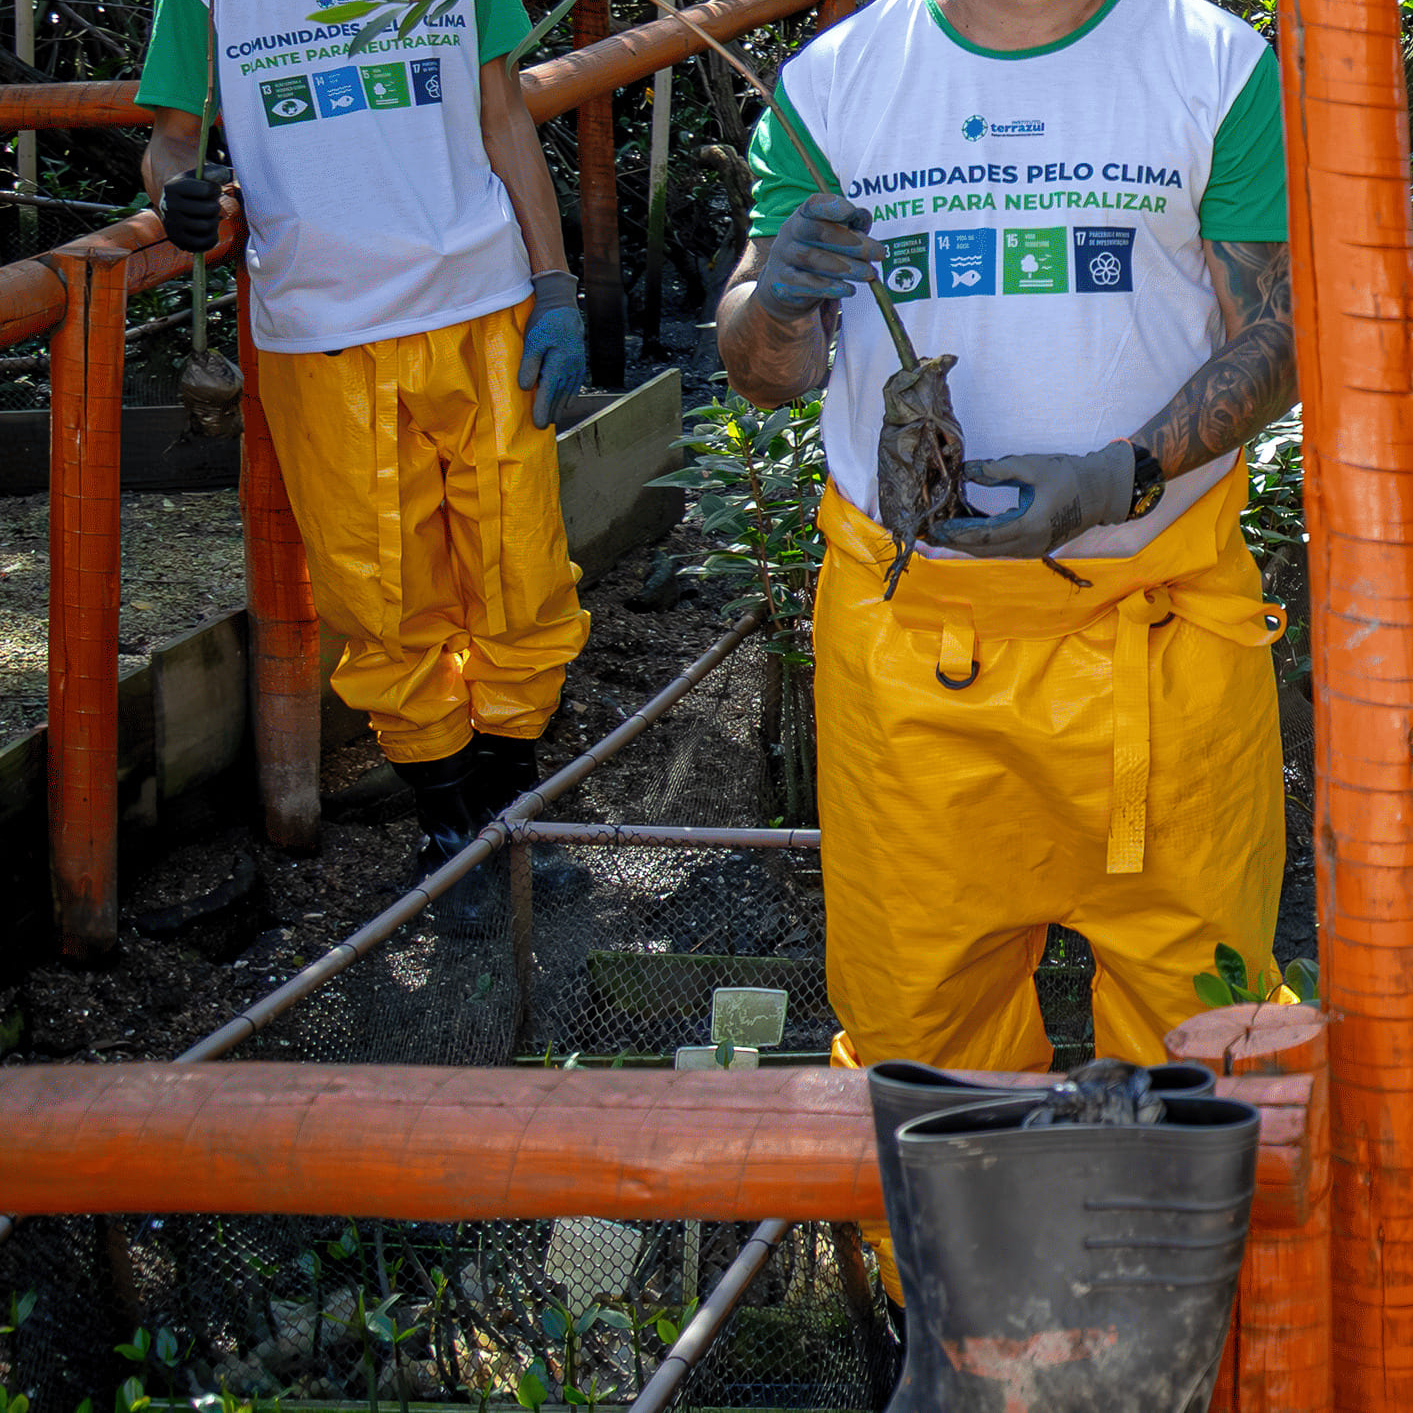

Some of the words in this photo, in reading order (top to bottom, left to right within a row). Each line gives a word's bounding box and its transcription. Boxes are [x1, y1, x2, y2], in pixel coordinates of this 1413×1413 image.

[226, 23, 361, 59] COMUNIDADES
[306, 43, 350, 66] PARA
[991, 122, 1045, 133] terrazul
[847, 163, 1018, 199] OMUNIDADES
[1027, 162, 1094, 184] PELO
[1102, 163, 1183, 188] CLIMA
[872, 198, 925, 222] ANTE
[932, 192, 997, 213] PARA
[1004, 190, 1167, 214] NEUTRALIZAR
[937, 236, 950, 250] 14
[1006, 234, 1018, 248] 15
[1075, 231, 1086, 246] 17
[884, 244, 891, 258] 3
